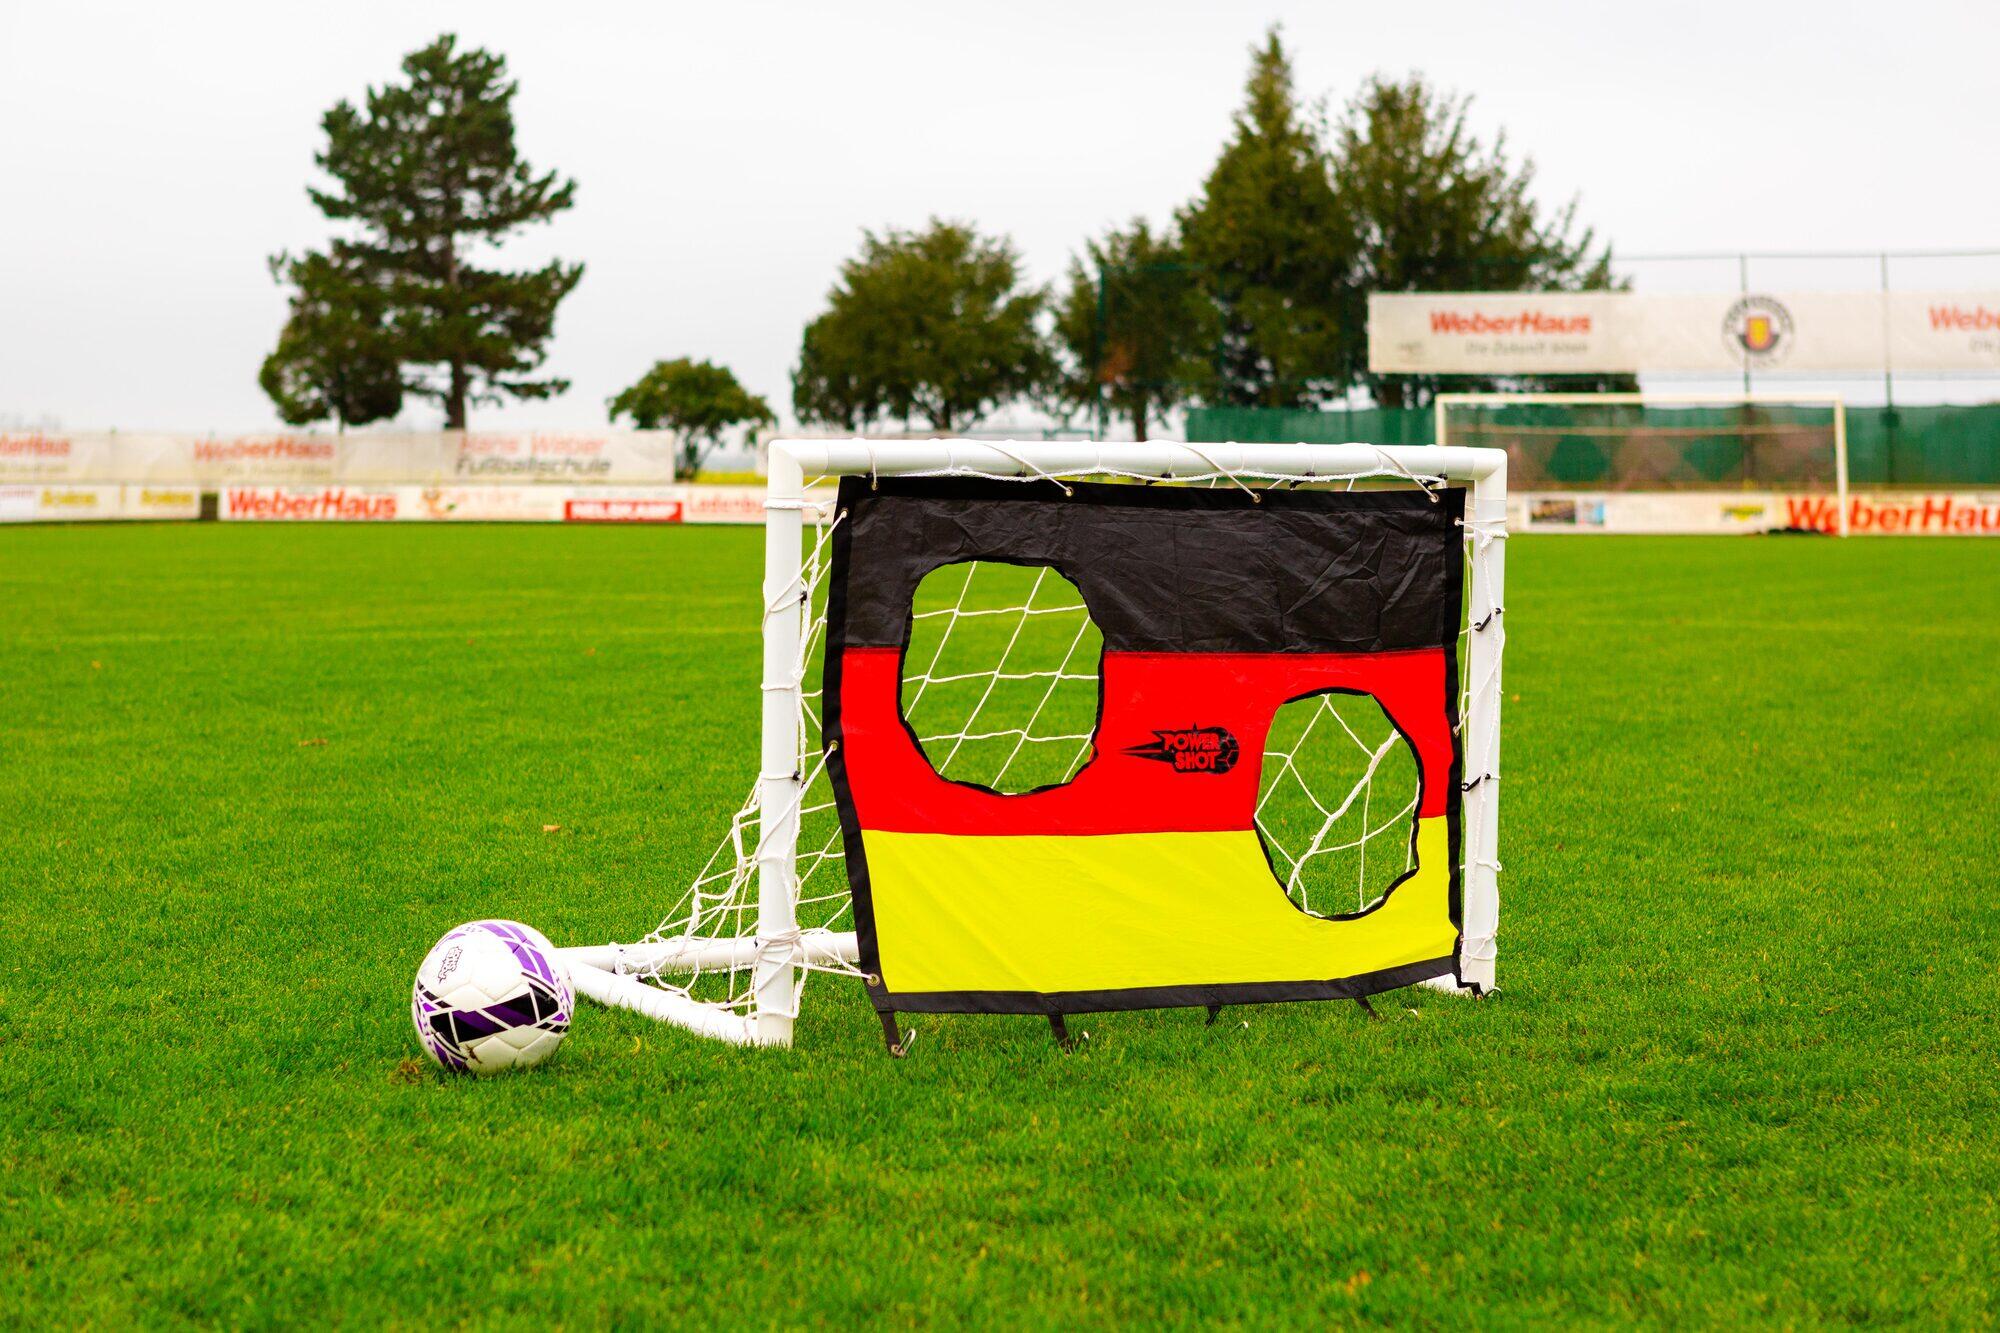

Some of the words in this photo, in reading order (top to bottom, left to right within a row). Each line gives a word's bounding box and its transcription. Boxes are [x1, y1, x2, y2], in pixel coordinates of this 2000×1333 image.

[1430, 309, 1591, 333] WeberHaus
[228, 488, 397, 520] WeberHaus
[1164, 732, 1220, 751] POWER
[1175, 751, 1221, 769] SHOT
